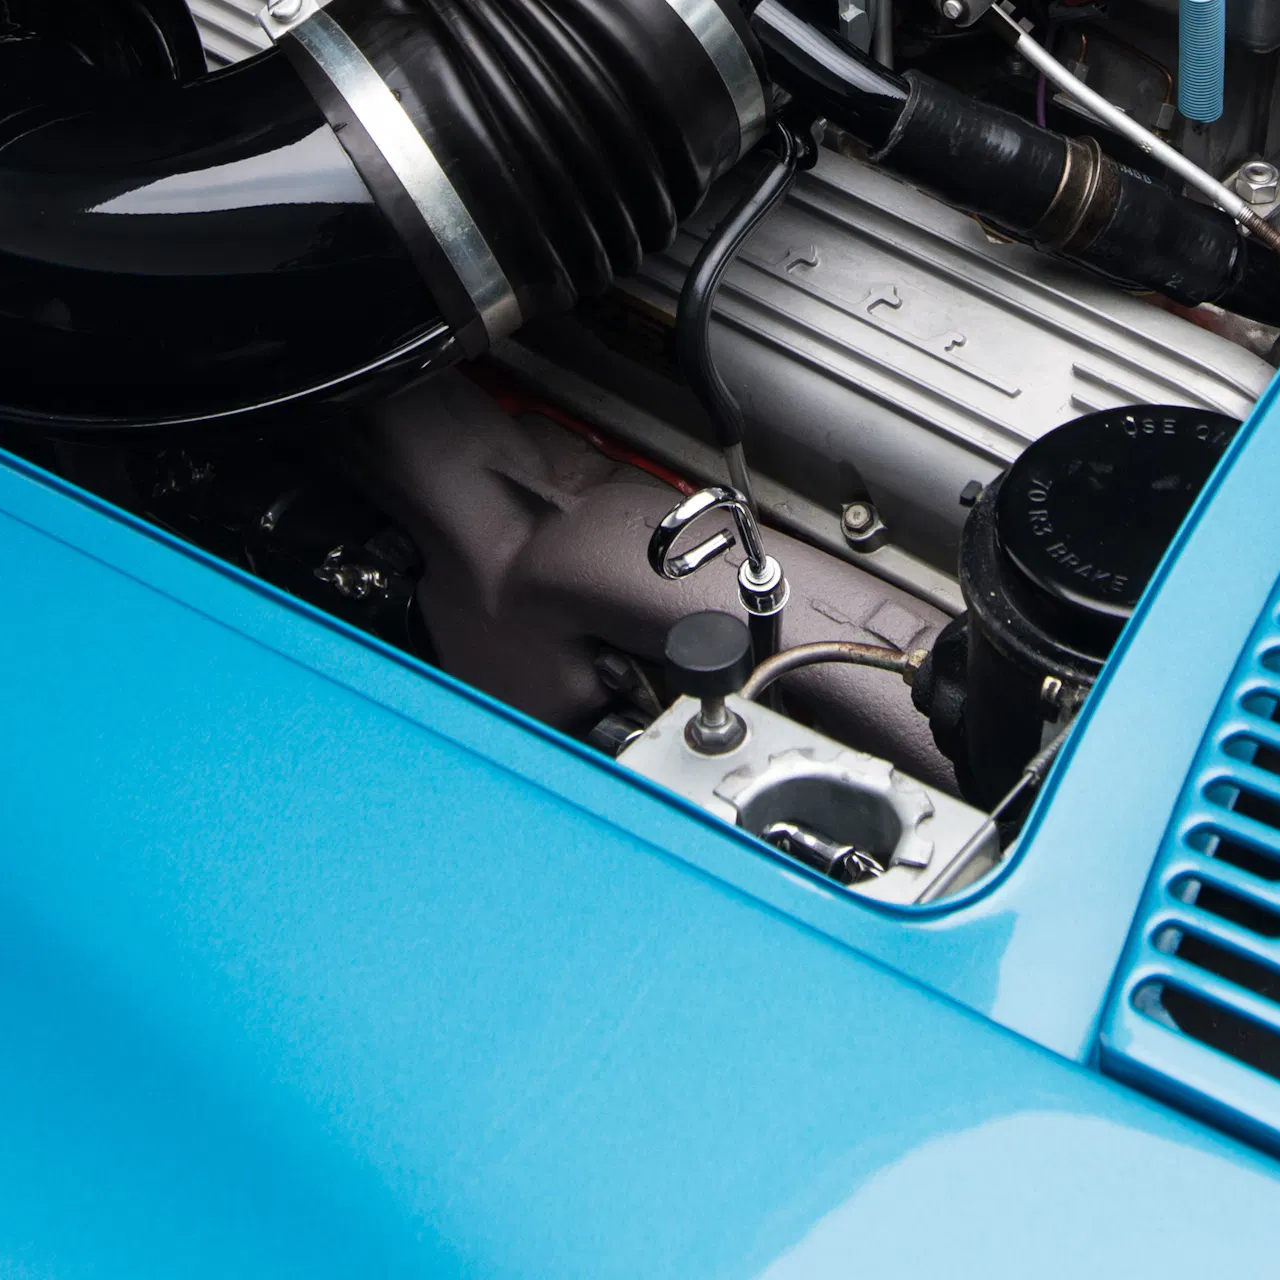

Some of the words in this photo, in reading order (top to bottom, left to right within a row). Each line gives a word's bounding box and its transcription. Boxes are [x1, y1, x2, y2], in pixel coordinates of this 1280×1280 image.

[1121, 416, 1176, 438] USE
[1028, 478, 1053, 502] 70
[1046, 542, 1128, 592] BRAKE
